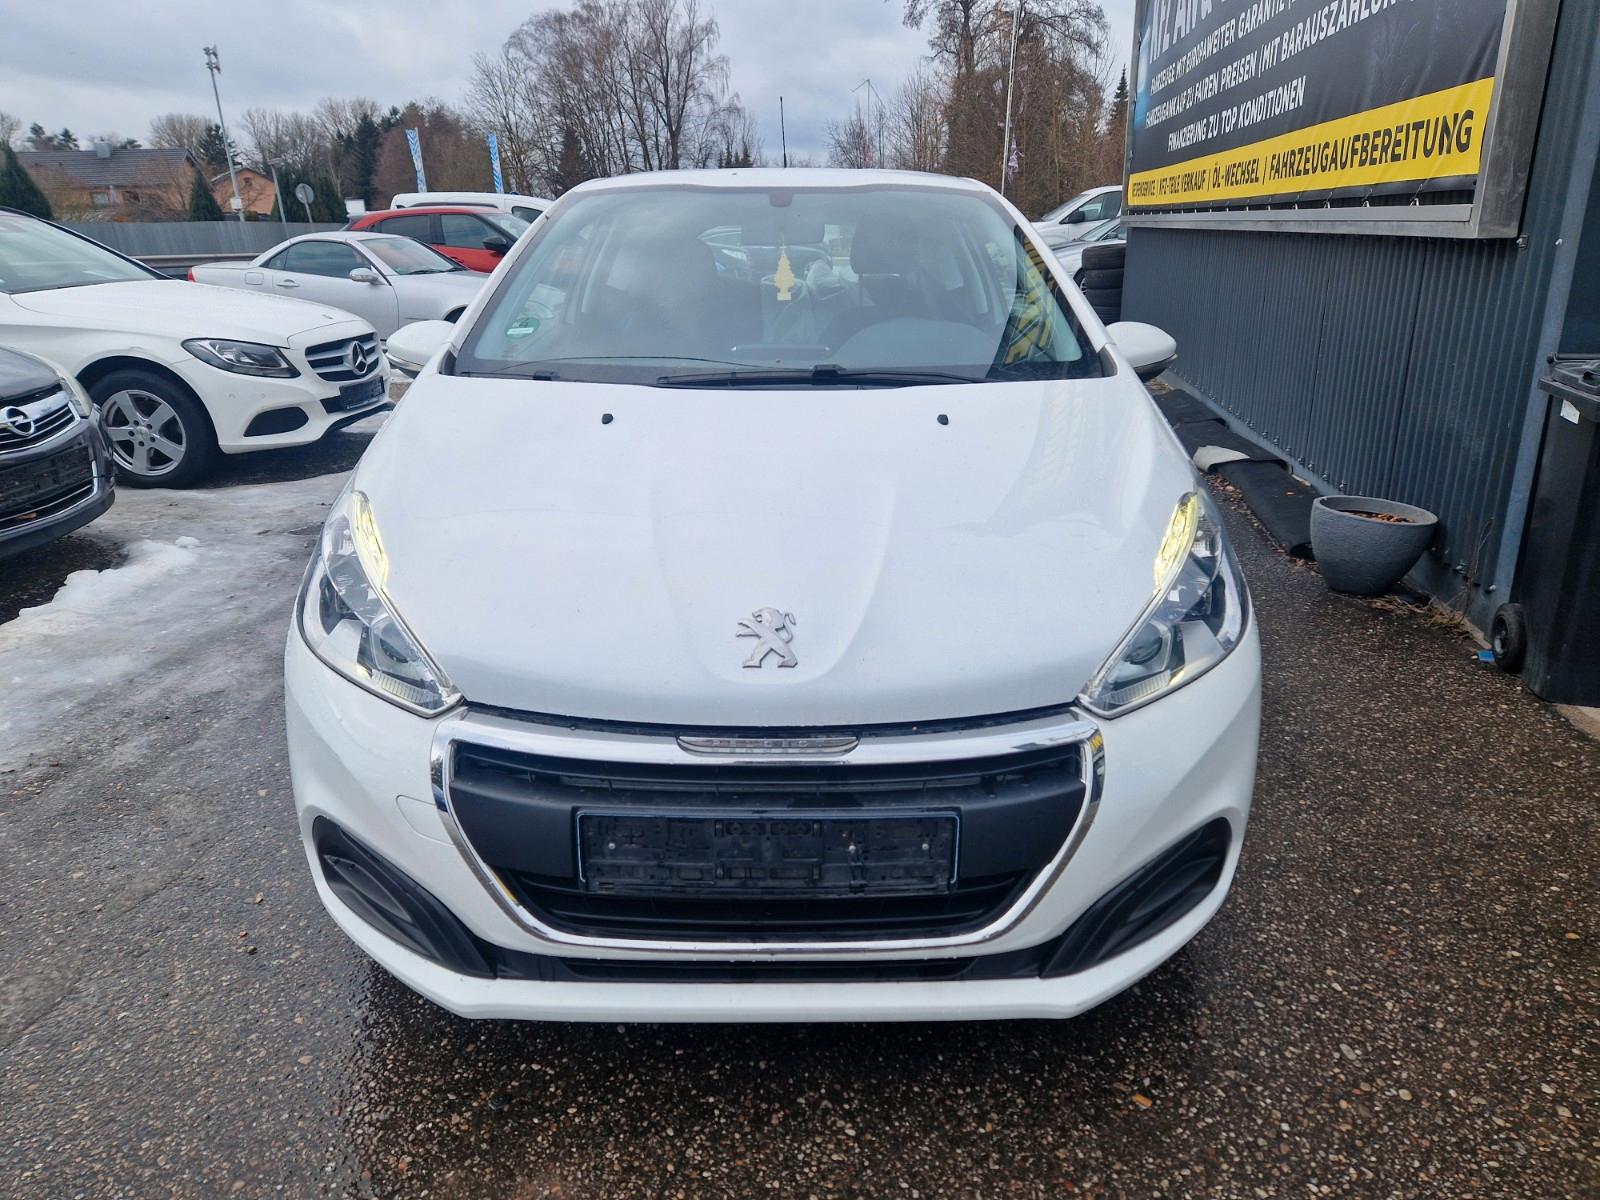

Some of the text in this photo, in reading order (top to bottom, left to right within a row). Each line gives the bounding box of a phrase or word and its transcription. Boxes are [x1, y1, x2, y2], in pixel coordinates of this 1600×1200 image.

[1176, 55, 1187, 80] MIT
[1186, 18, 1236, 73] EUROPAWEITER
[1186, 86, 1195, 111] ZU
[1194, 71, 1219, 106] FAIREN
[1220, 50, 1258, 92] PREISEN
[1168, 75, 1306, 153] FINANZIERUNG ZU TOP KONDITIONEN
[1180, 169, 1207, 193] VERKAUF
[1269, 109, 1474, 180] FAHRZEUGAUFBEREITUNG
